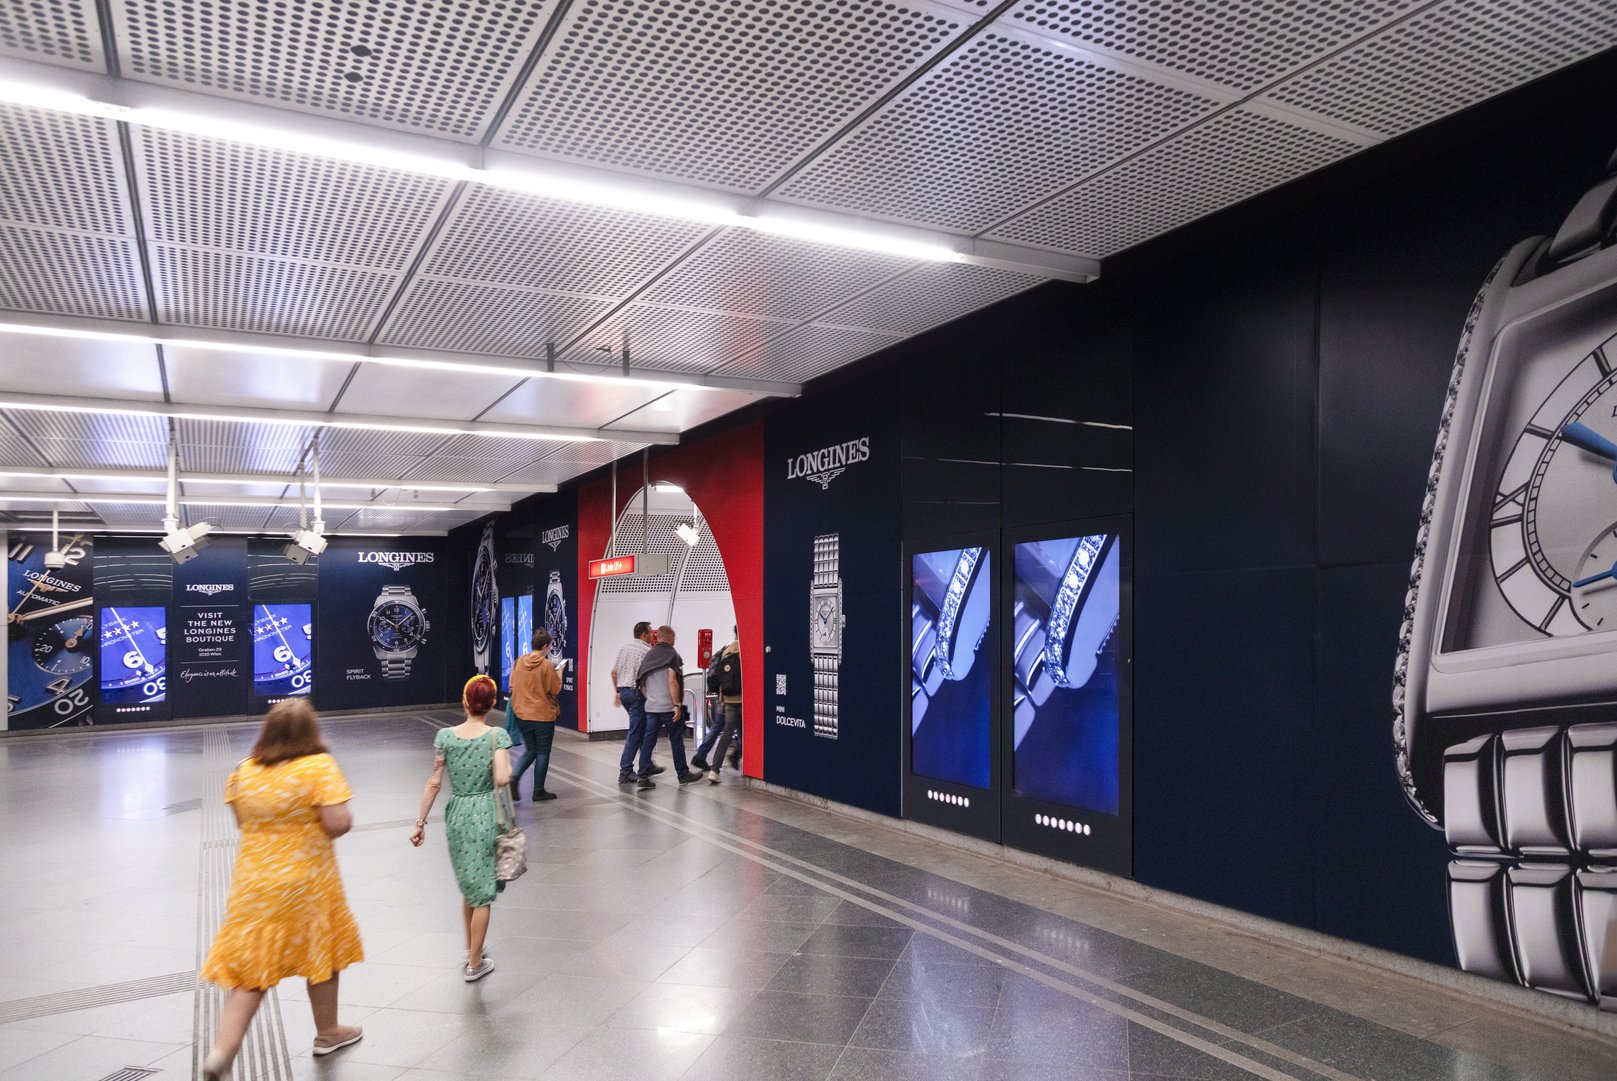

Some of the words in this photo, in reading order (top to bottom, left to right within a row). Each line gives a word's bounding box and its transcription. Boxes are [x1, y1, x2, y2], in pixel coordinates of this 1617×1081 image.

[787, 437, 870, 480] LONGINES
[542, 524, 569, 544] LONGINES
[357, 551, 435, 563] LONGINES
[23, 569, 82, 593] LONGINES
[186, 584, 234, 592] LONGINES
[184, 627, 236, 635] LONGINES
[186, 635, 234, 643] BOUTIQUE
[123, 651, 144, 669] 6
[273, 645, 292, 663] 6
[776, 715, 807, 729] DOLCEVITA
